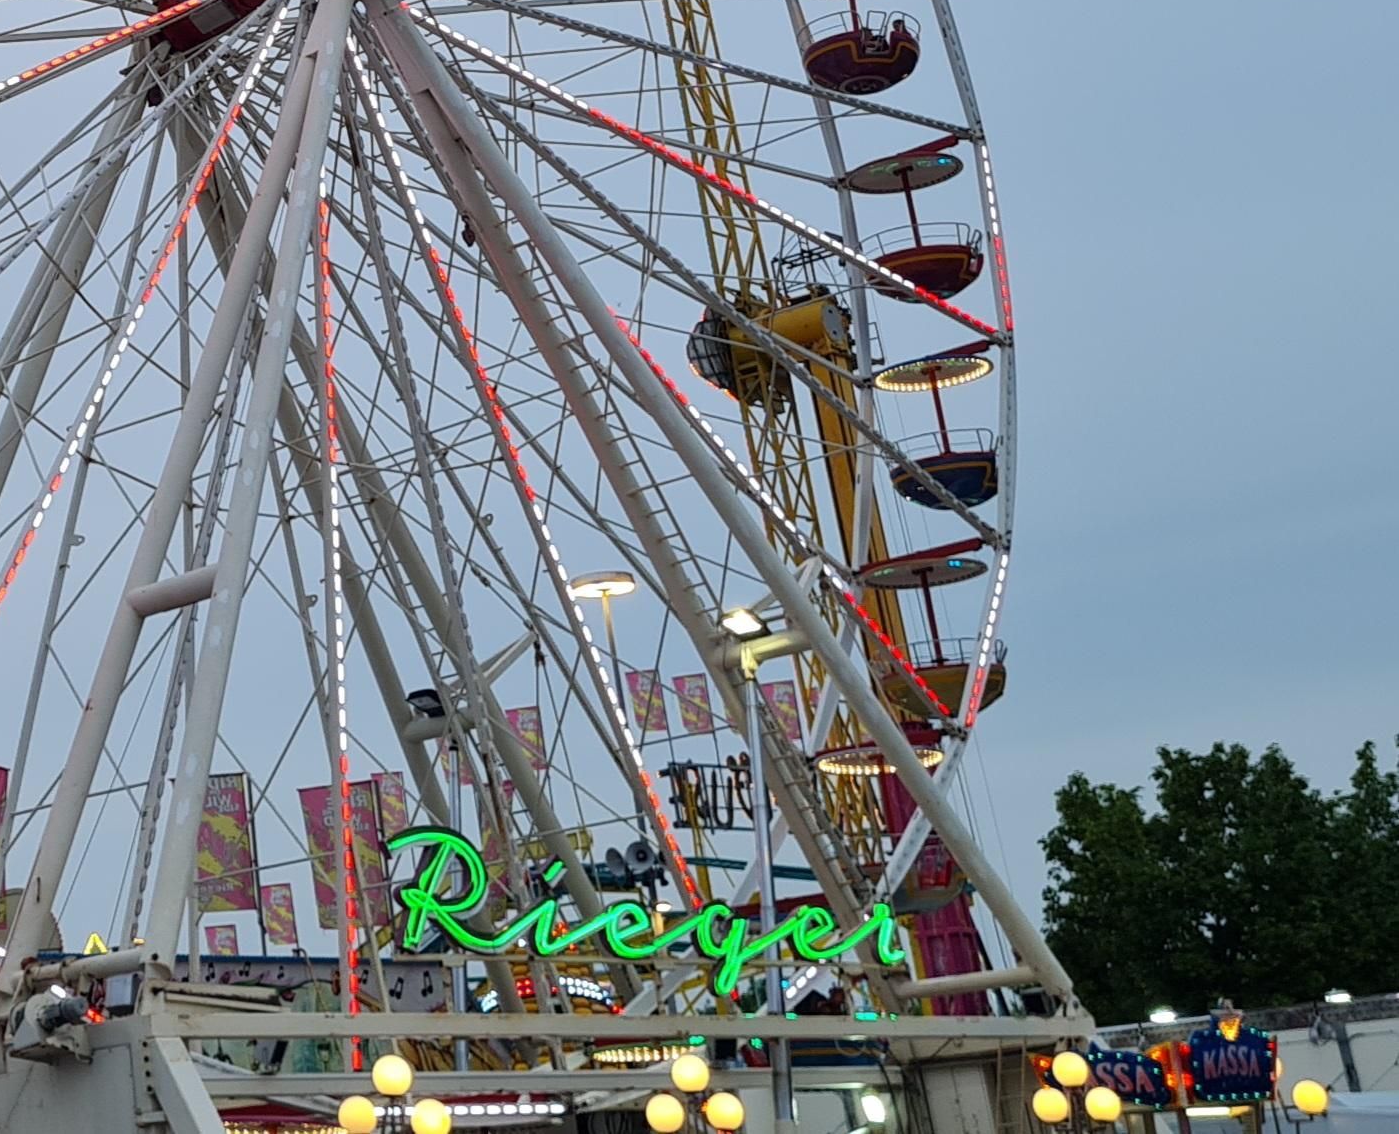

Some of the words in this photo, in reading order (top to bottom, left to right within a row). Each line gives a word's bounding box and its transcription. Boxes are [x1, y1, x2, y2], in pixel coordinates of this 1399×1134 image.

[384, 828, 906, 997] Rieger
[1085, 1061, 1155, 1094] ASSA
[1204, 1044, 1261, 1080] KASSA
